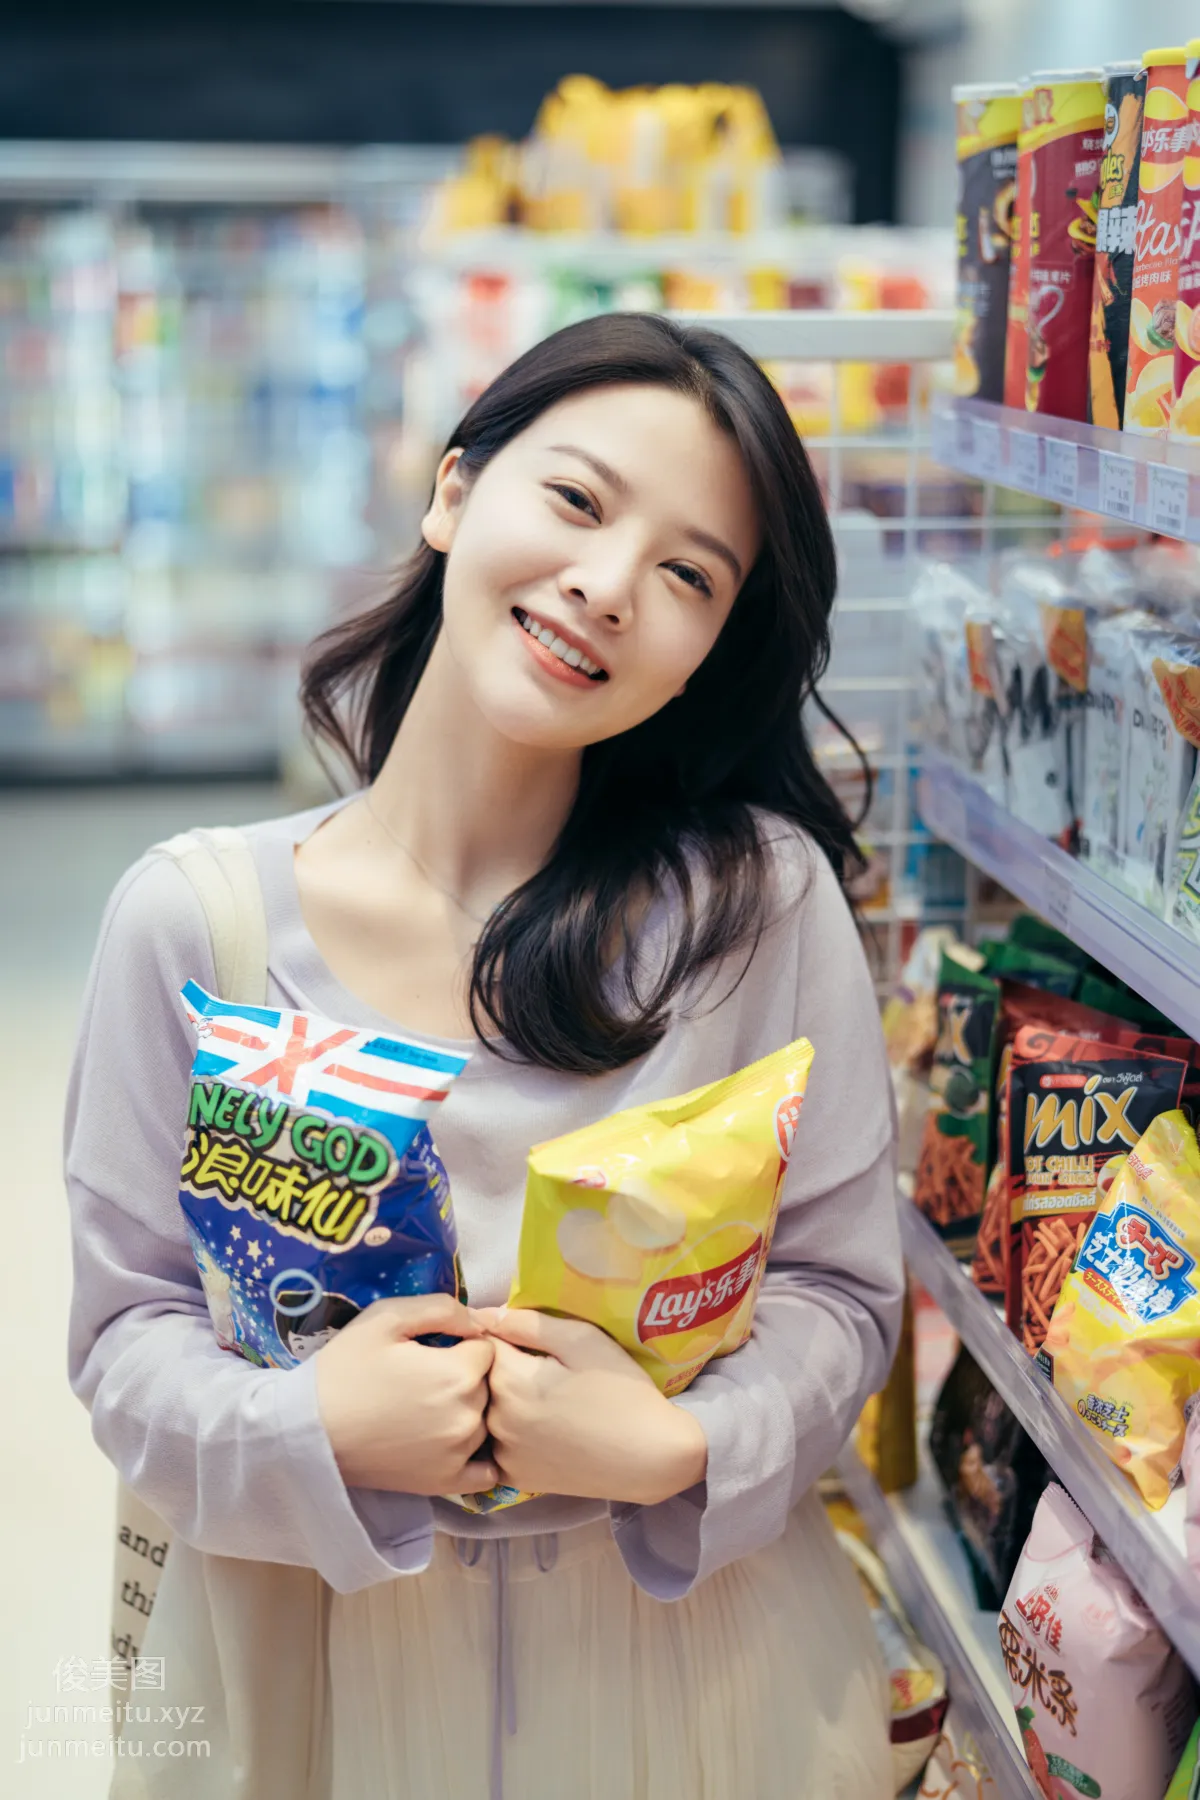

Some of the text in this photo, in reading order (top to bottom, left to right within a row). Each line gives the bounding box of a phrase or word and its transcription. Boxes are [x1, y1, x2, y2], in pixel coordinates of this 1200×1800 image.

[290, 1114, 390, 1184] GOD
[1045, 1155, 1095, 1173] CHILLI
[180, 1132, 367, 1243] 浪味仙
[1120, 1217, 1179, 1276] チーズ
[643, 1256, 757, 1328] Lay's 乐事
[119, 1525, 169, 1568] and
